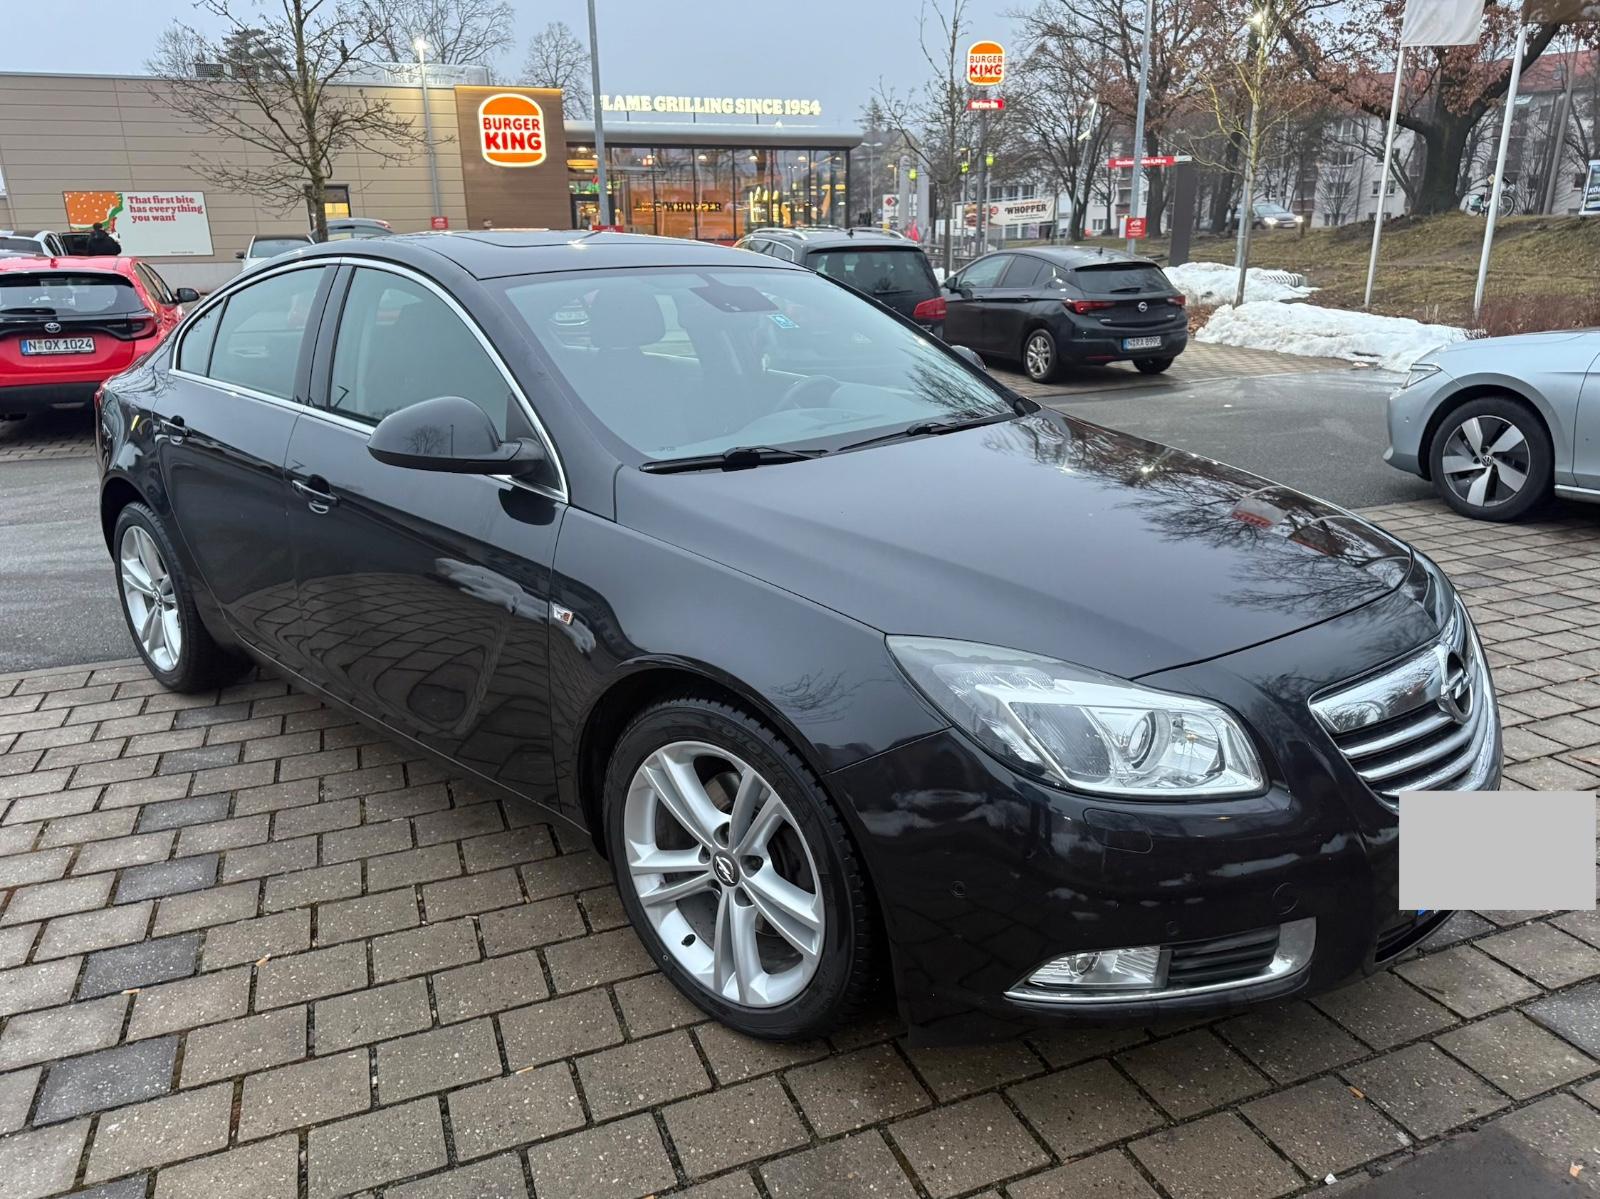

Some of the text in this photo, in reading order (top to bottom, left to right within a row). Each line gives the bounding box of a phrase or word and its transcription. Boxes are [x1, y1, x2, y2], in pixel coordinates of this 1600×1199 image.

[970, 55, 1003, 63] BURGER
[970, 64, 1002, 75] KING
[653, 96, 735, 113] GRILLING
[735, 98, 783, 115] SINCE
[784, 99, 821, 115] 1954
[483, 117, 541, 131] BURGER
[485, 131, 542, 151] KING
[127, 195, 195, 204] That first bite
[129, 204, 204, 214] has everything
[1004, 204, 1047, 215] WHOPPER
[131, 214, 176, 224] you want
[28, 338, 93, 351] N QX 1024
